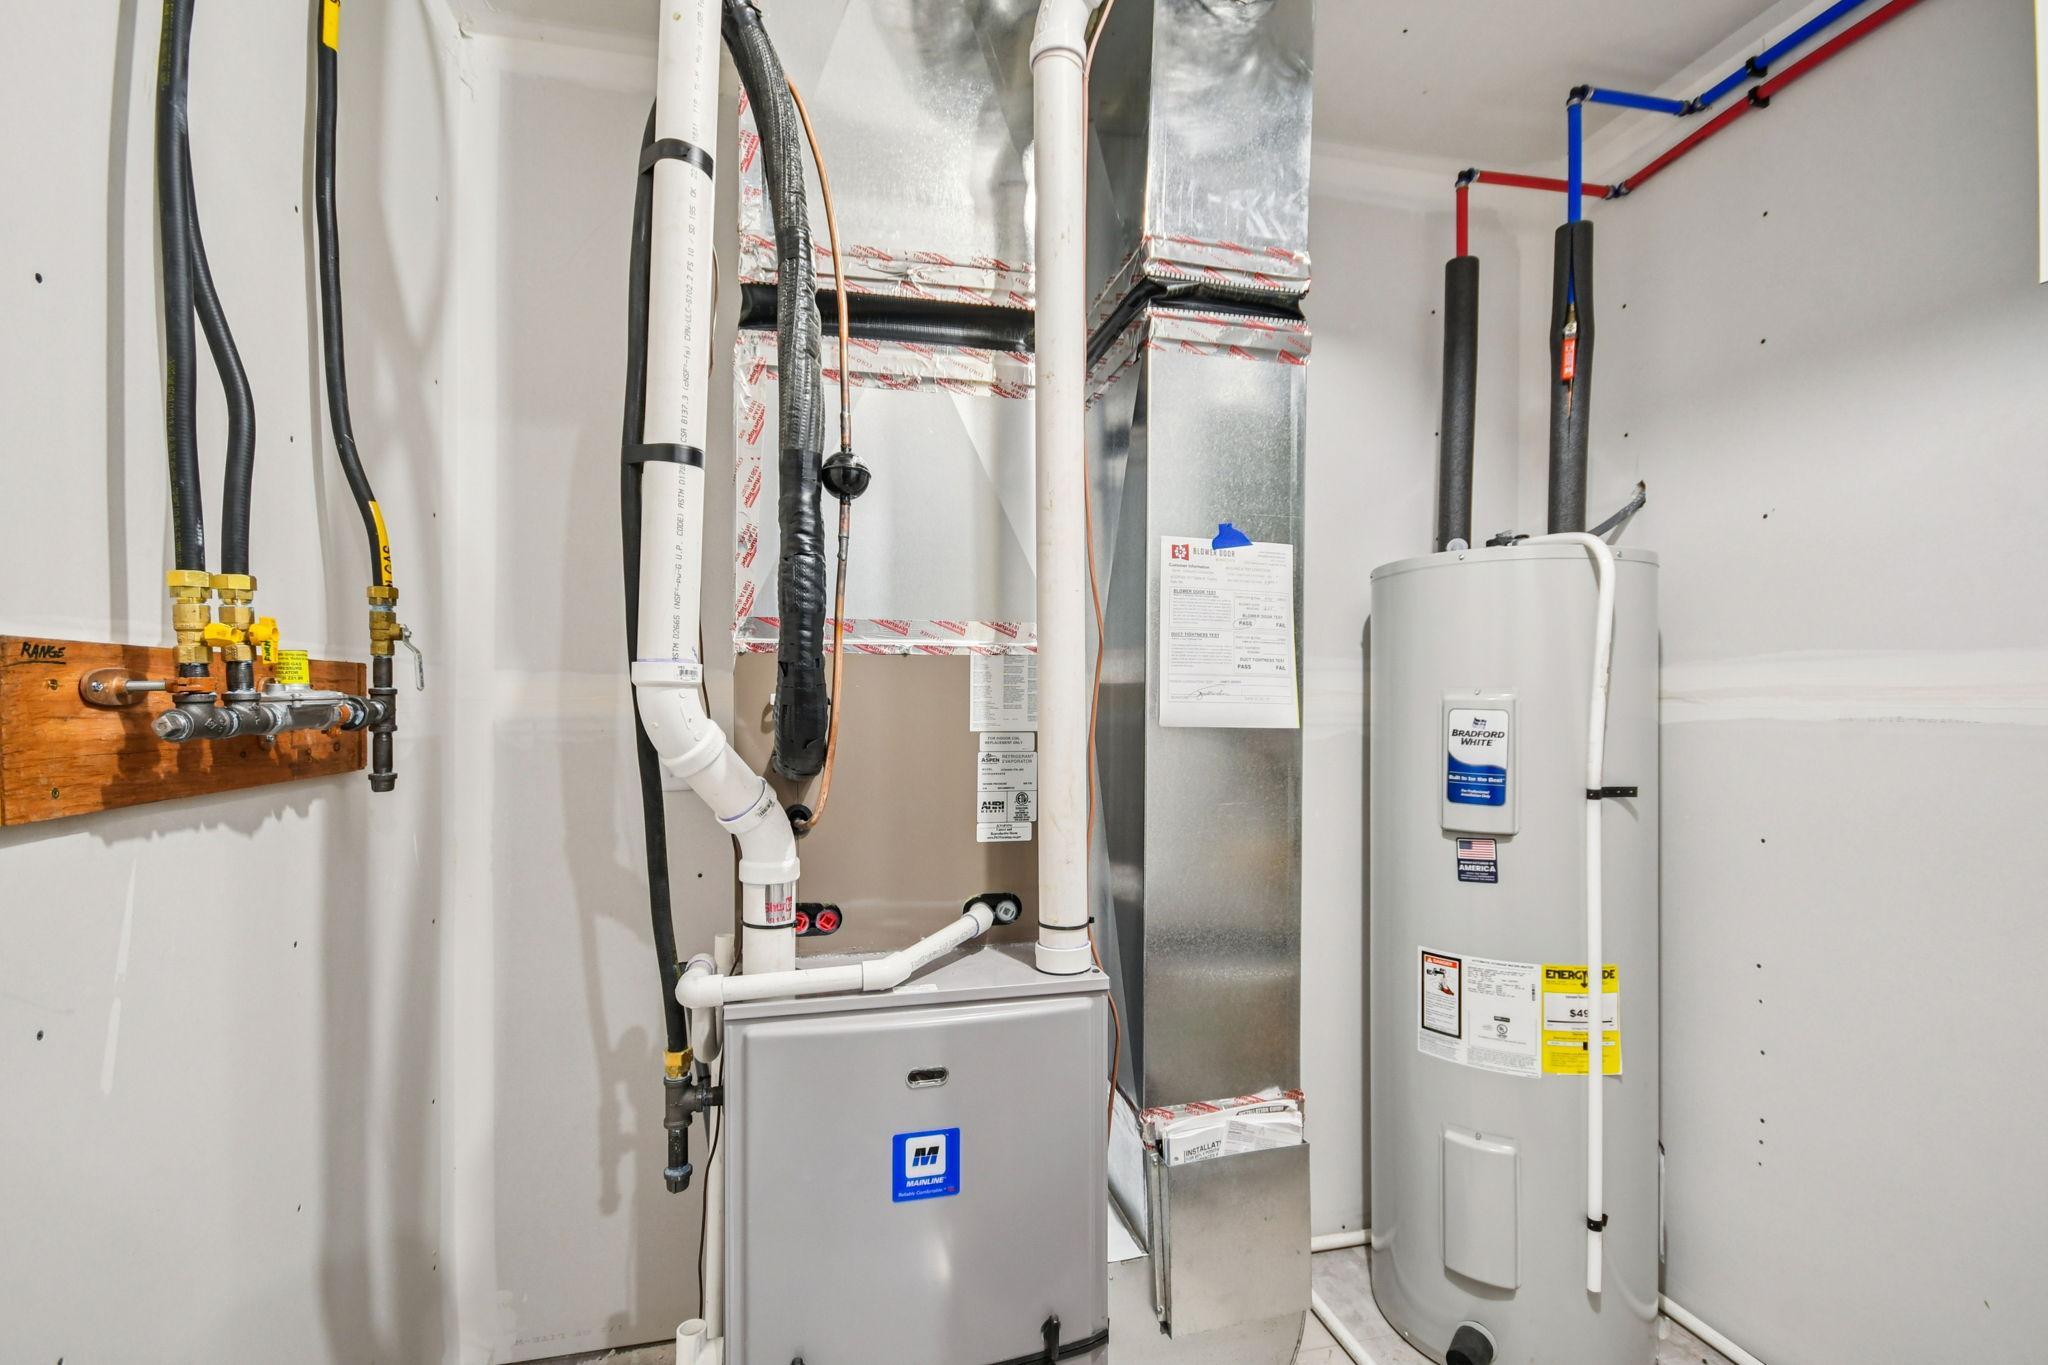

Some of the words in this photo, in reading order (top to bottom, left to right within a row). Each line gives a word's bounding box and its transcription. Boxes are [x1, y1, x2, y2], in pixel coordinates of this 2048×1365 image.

[680, 427, 688, 443] CSA
[679, 464, 688, 486] D178
[678, 488, 686, 509] ASTM
[21, 641, 66, 659] RANGE
[1451, 729, 1505, 739] BRADFORD
[1460, 738, 1493, 747] WHITE
[1546, 969, 1615, 981] ENERGYDE
[1186, 1140, 1223, 1157] INSTALLAT
[906, 1177, 944, 1187] MAINLINE
